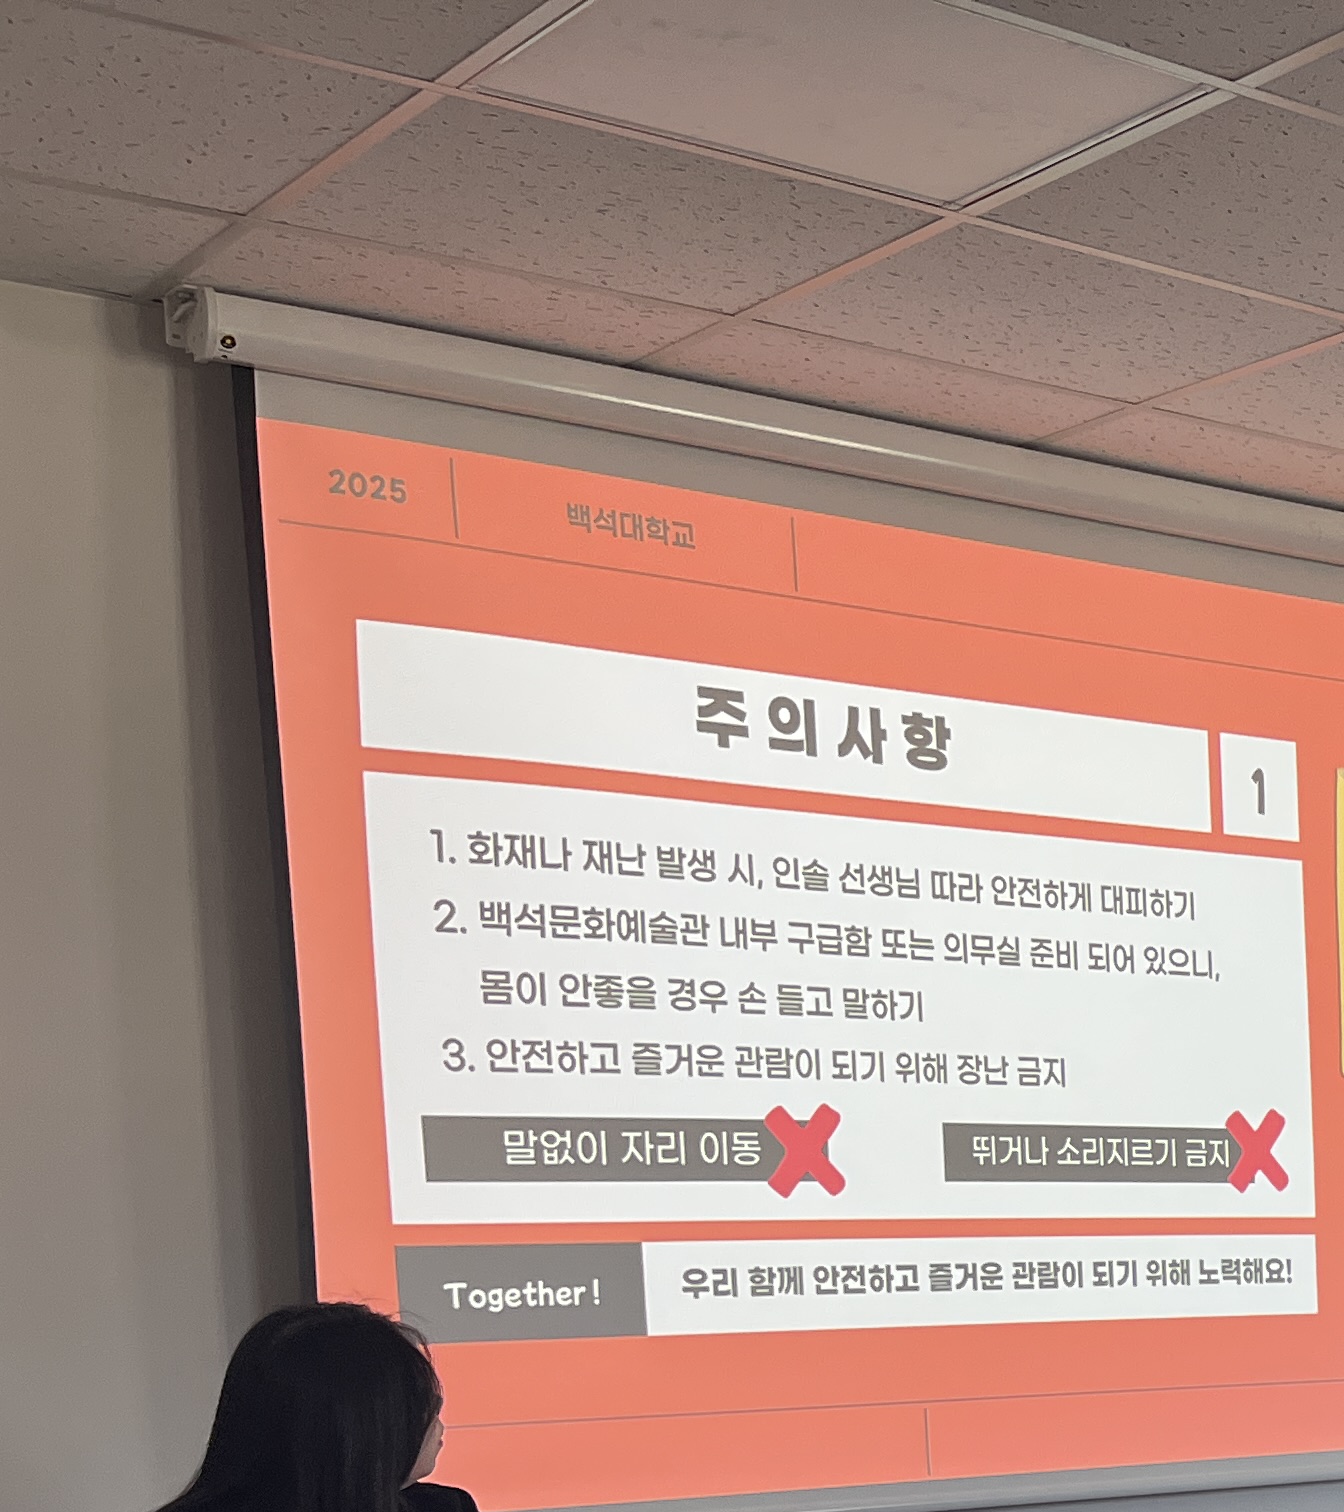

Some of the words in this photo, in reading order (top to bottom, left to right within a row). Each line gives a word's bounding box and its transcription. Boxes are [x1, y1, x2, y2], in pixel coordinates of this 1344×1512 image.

[327, 468, 406, 504] 2025
[566, 502, 696, 550] 백석대학교
[695, 685, 952, 770] 주의사항
[1251, 768, 1266, 816] 1
[429, 828, 457, 865] 1.
[466, 830, 573, 872] 화재나
[582, 839, 647, 877] 재난
[656, 845, 717, 883] 발생
[727, 853, 763, 890] 시,
[772, 856, 830, 892] 인솔
[838, 862, 921, 900] 선생님
[930, 870, 984, 904] 따라
[991, 875, 1092, 913] 안전하게
[1100, 885, 1195, 921] 대피하기
[433, 899, 467, 935] 2.
[479, 900, 710, 947] 백석문화예술관
[719, 916, 779, 952] 내부
[787, 921, 873, 958] 구급함
[881, 928, 935, 962] 또는
[943, 932, 1021, 967] 의무실
[1030, 937, 1079, 971] 준비
[1087, 942, 1135, 975] 되어
[1143, 946, 1220, 982] 있으니,
[479, 969, 547, 1007] 몸이
[558, 973, 657, 1010] 안좋을
[667, 978, 729, 1014] 경우
[738, 981, 767, 1015] 손
[776, 983, 834, 1017] 들고
[842, 987, 923, 1023] 말하기
[442, 1037, 476, 1072] 3.
[486, 1038, 622, 1076] 안전하고
[631, 1042, 725, 1078] 즐거운
[734, 1046, 821, 1081] 관람이
[831, 1049, 885, 1083] 되기
[895, 1052, 948, 1084] 위해
[956, 1054, 1010, 1086] 장난
[1016, 1056, 1066, 1088] 금지
[503, 1129, 607, 1166] 말없이
[621, 1130, 686, 1166] 자리
[699, 1131, 762, 1166] 이동
[972, 1135, 1050, 1166] 뛰거나
[1057, 1136, 1177, 1167] 소리지르기
[1185, 1139, 1230, 1168] 금지
[681, 1267, 738, 1300] 우리
[747, 1265, 805, 1297] 함께
[813, 1264, 920, 1296] 안전하고
[928, 1262, 1004, 1292] 즐거운
[1012, 1260, 1084, 1290] 관람이
[1092, 1259, 1138, 1288] 되기
[1146, 1259, 1191, 1287] 위해
[1198, 1257, 1293, 1286] 노력해요!
